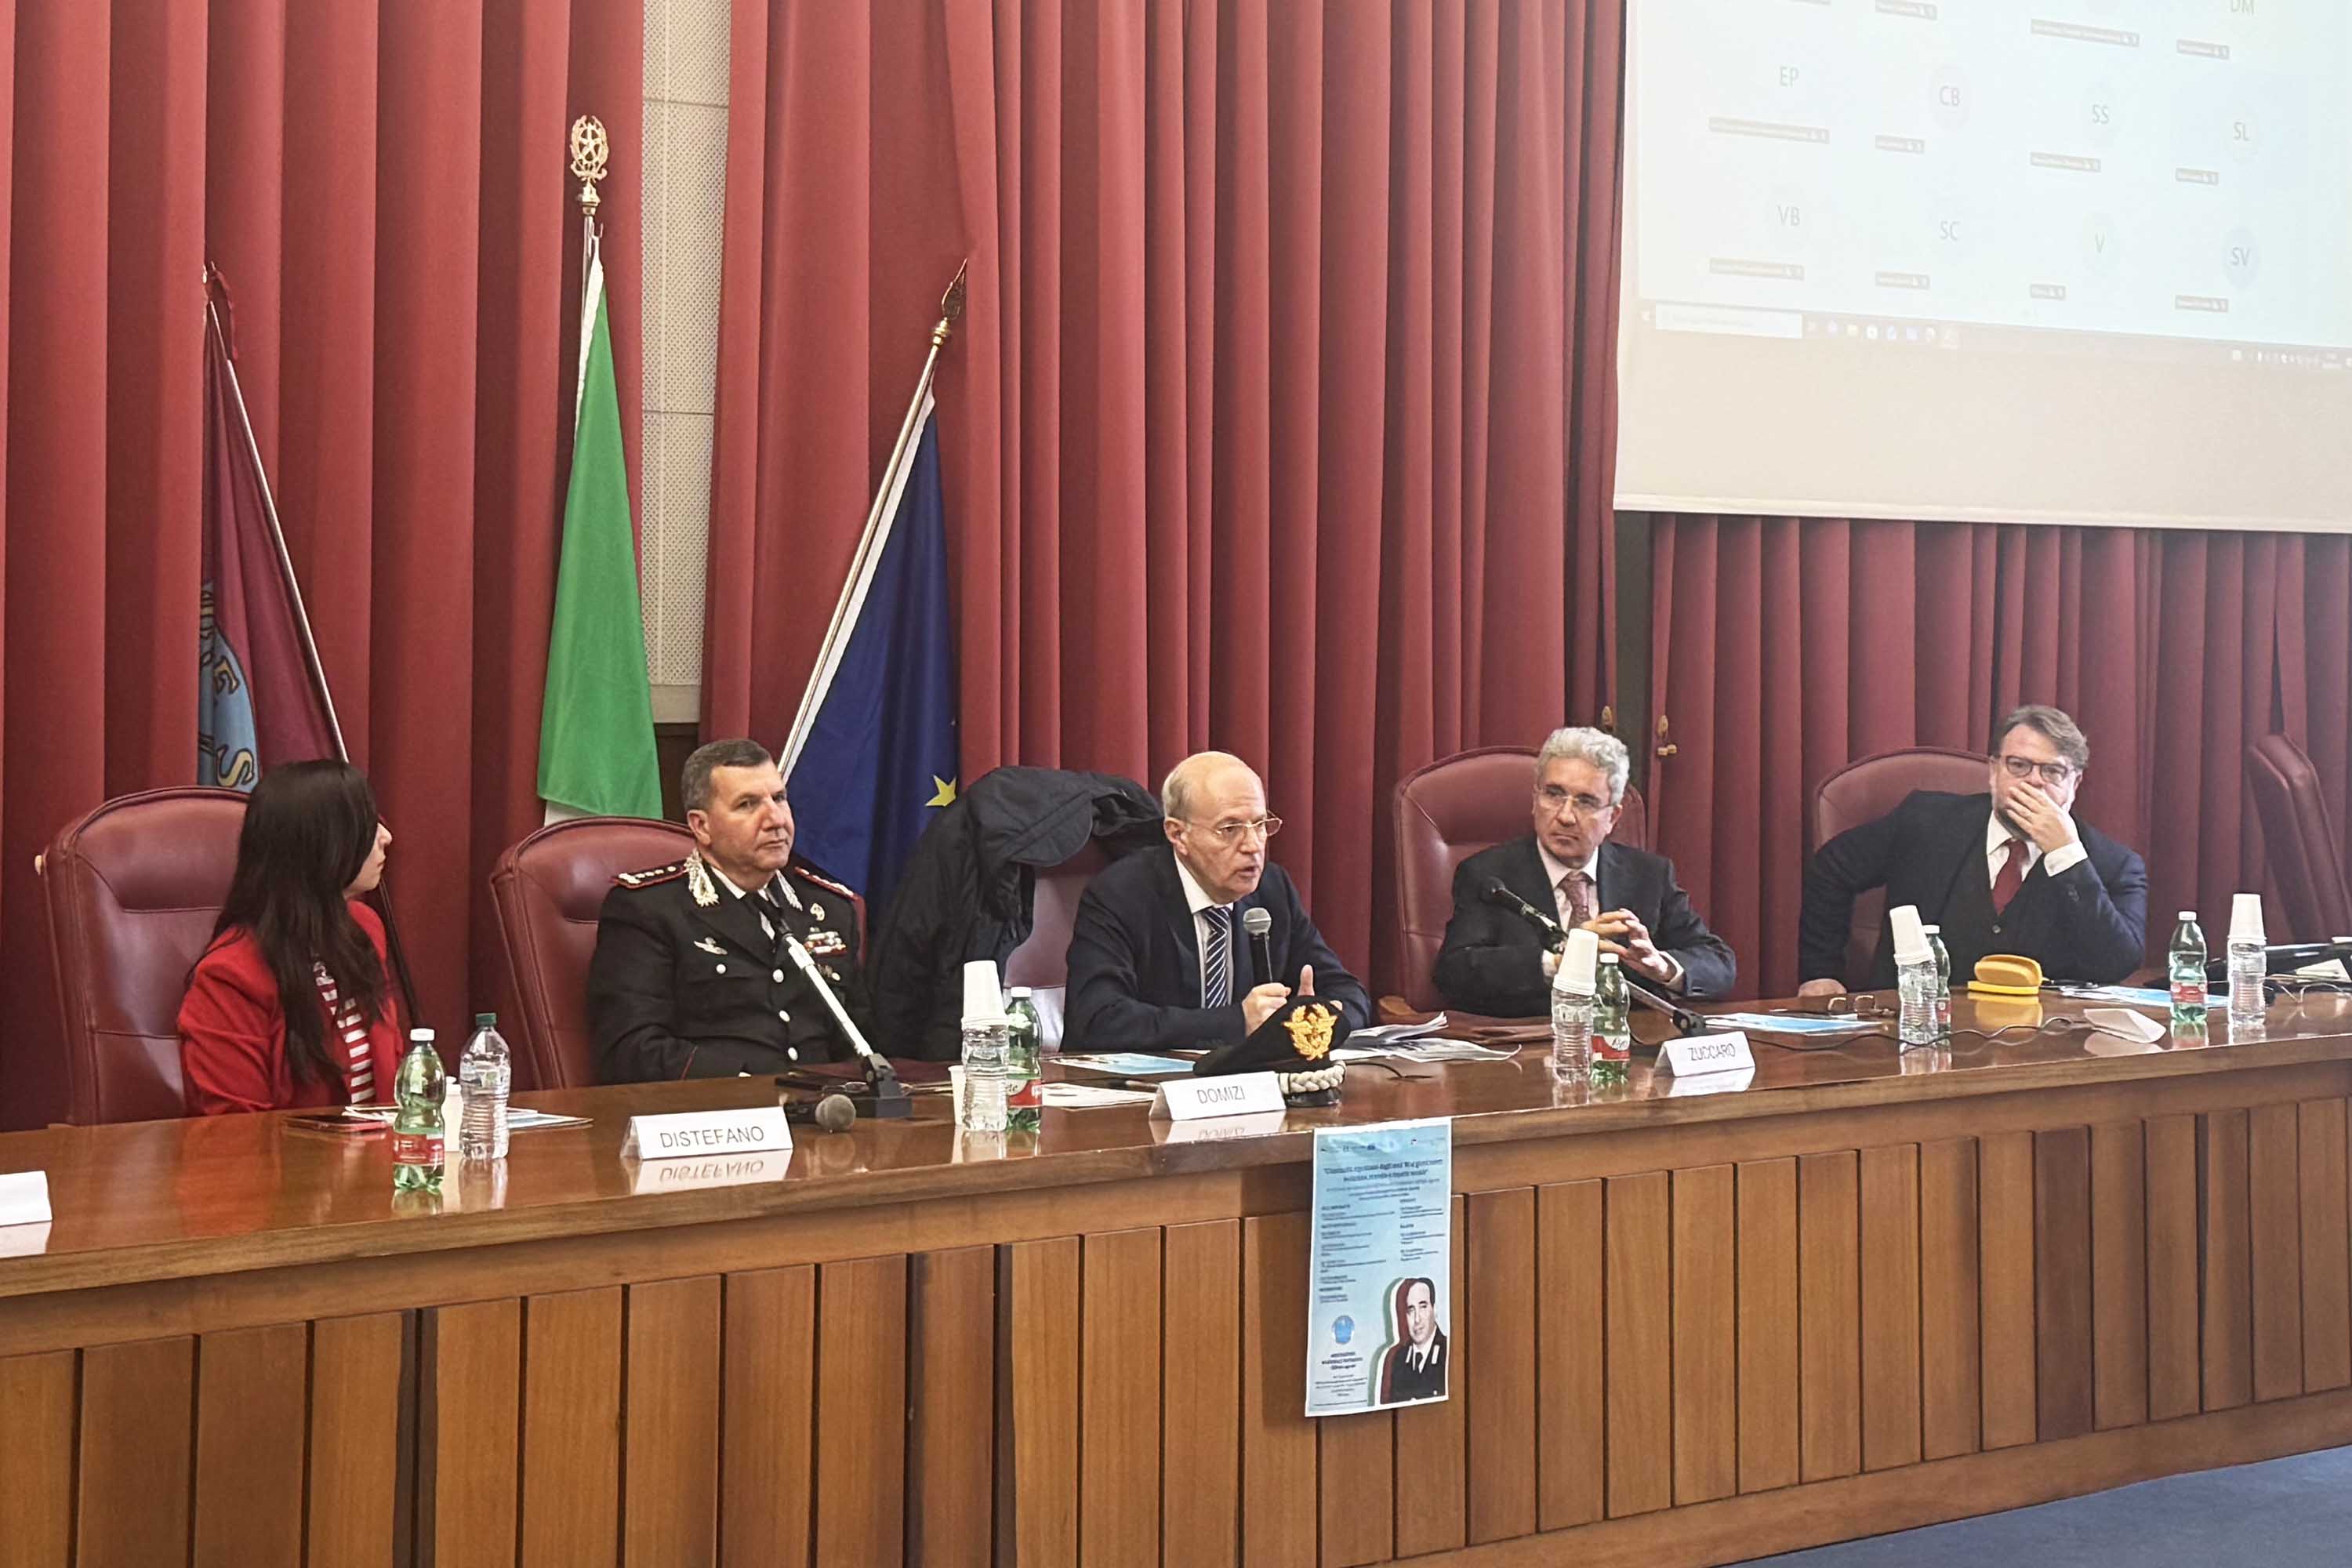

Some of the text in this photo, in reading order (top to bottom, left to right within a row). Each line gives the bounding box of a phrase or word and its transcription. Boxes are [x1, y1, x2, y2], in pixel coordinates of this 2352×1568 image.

[1779, 66, 1800, 87] EP
[1939, 85, 1961, 107] CB
[2091, 103, 2110, 125] SS
[2233, 122, 2250, 142] SL
[1777, 205, 1801, 227] VB
[1939, 220, 1960, 241] SC
[2231, 246, 2251, 267] SV
[1687, 1043, 1736, 1062] ZUCCARO
[1196, 1085, 1246, 1105] DOMIZI
[659, 1126, 764, 1149] DISTEFANO
